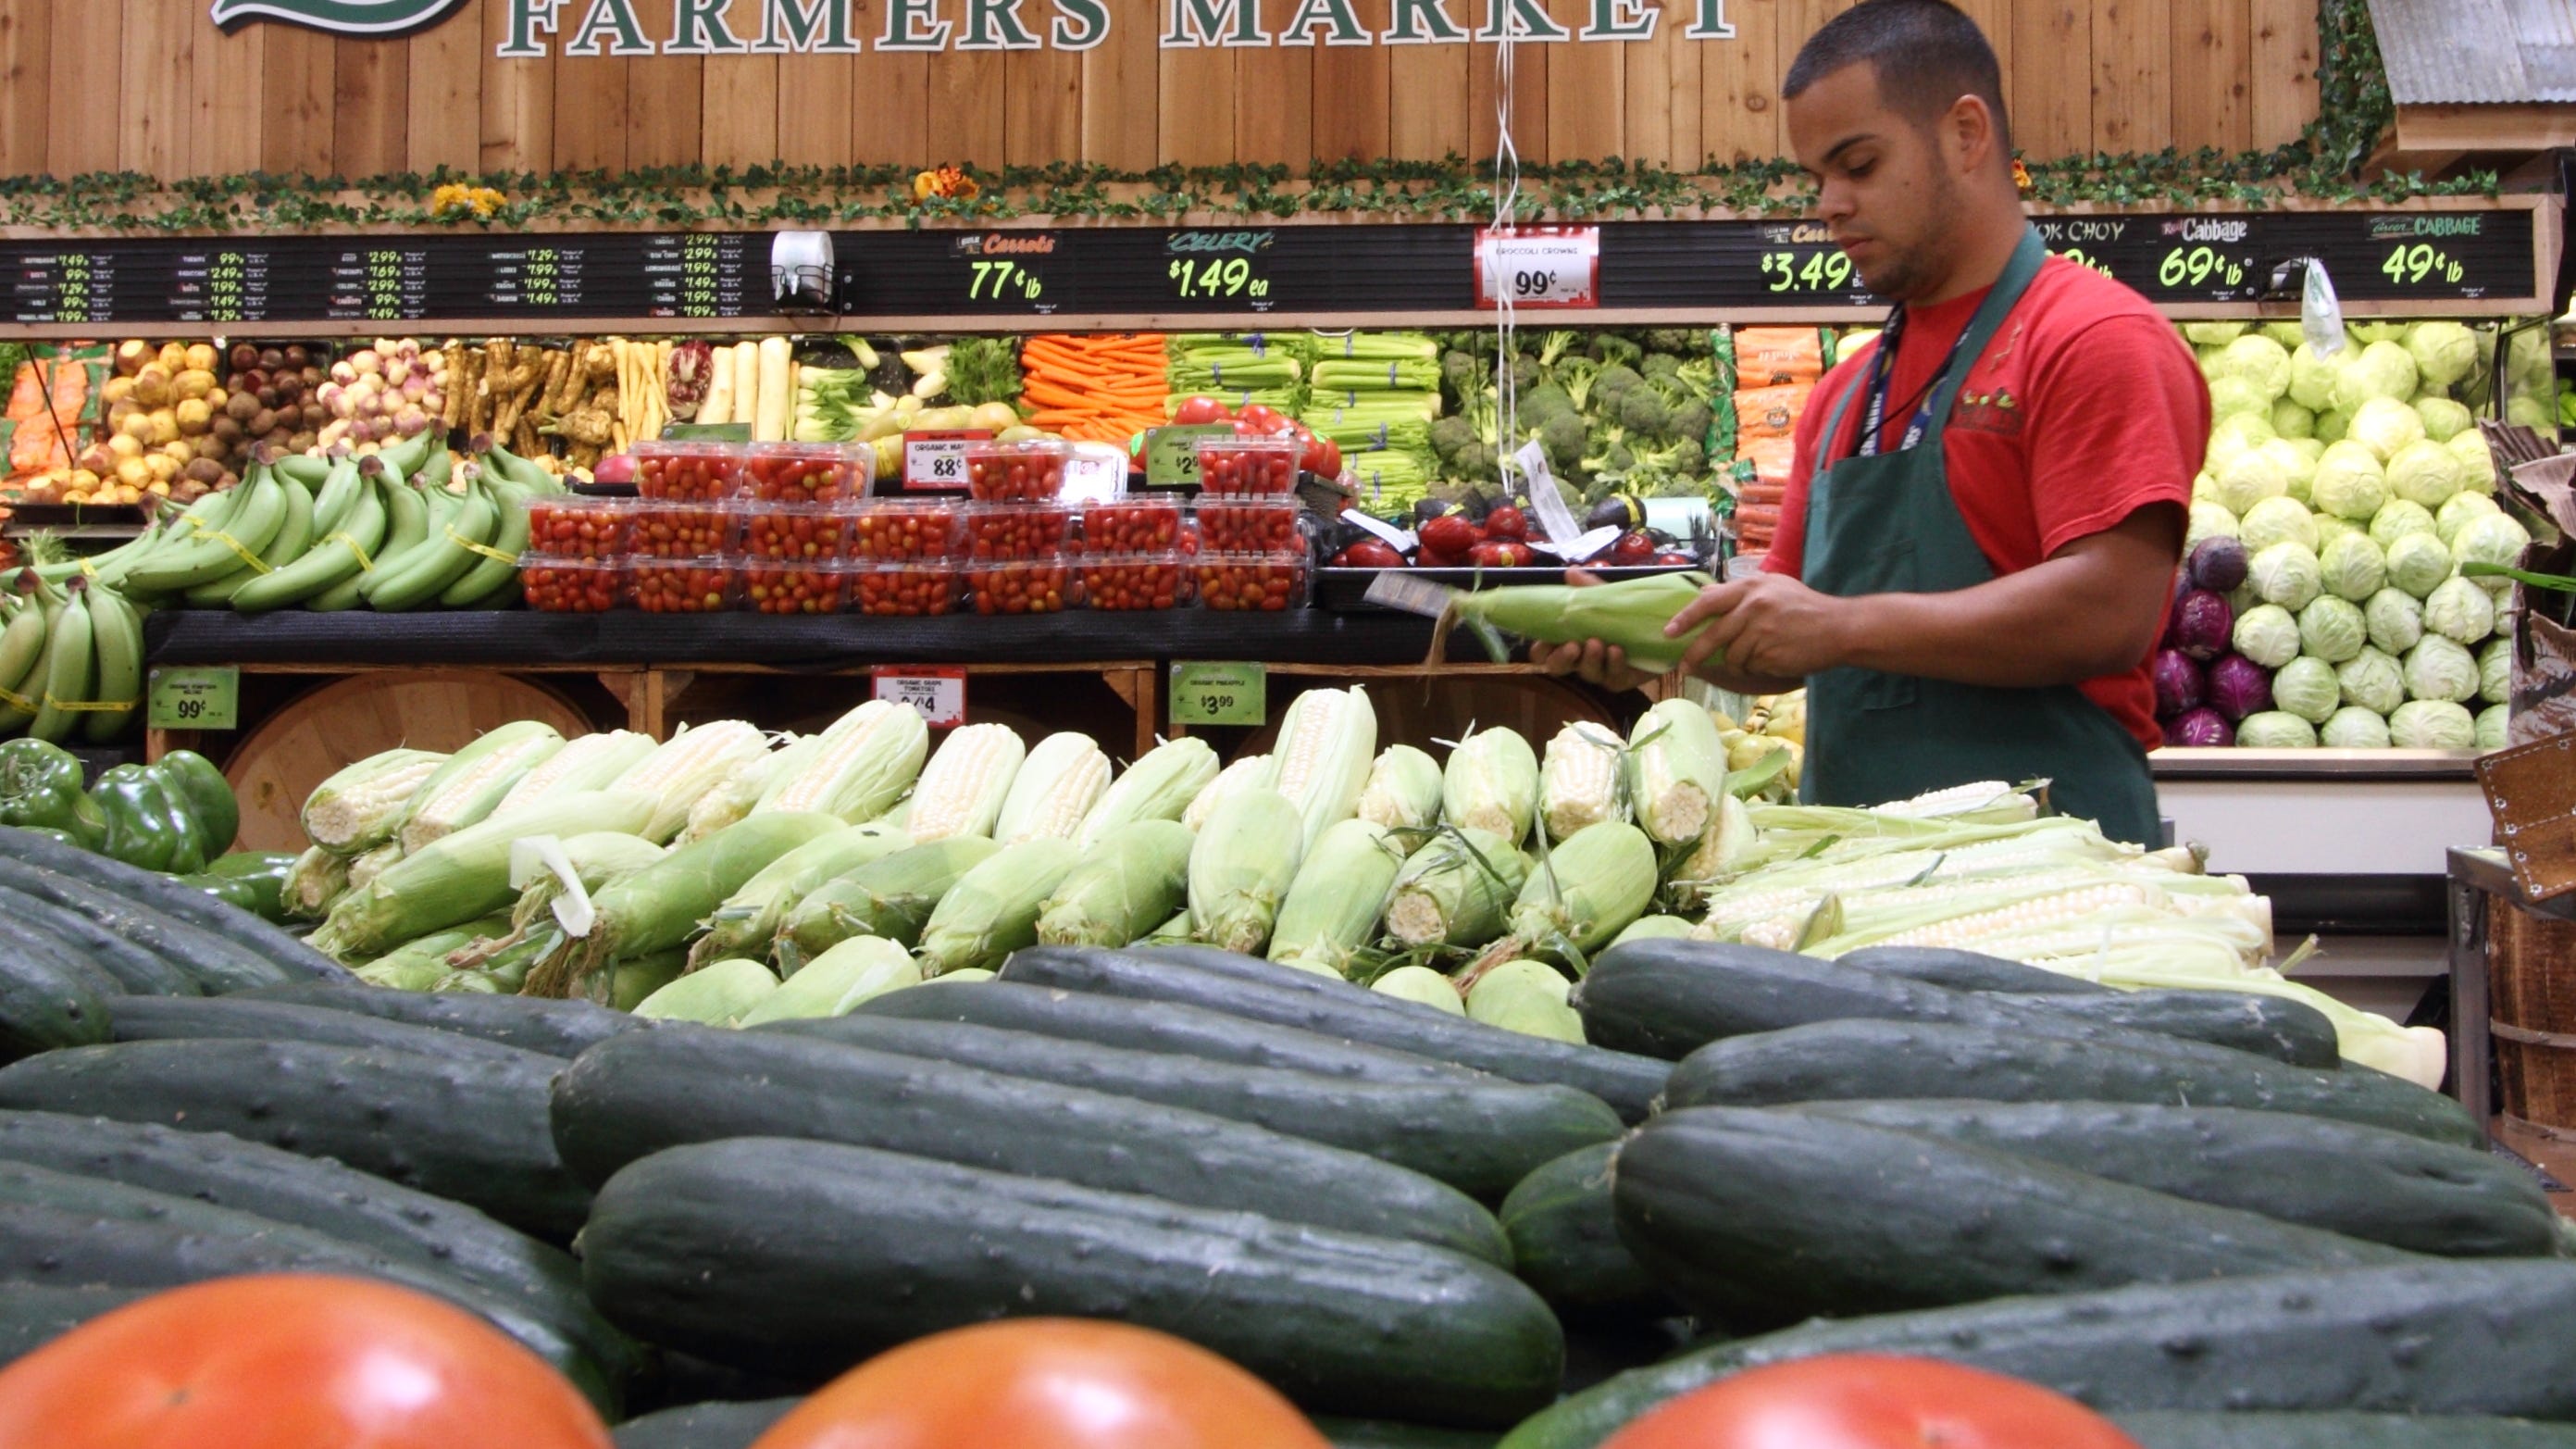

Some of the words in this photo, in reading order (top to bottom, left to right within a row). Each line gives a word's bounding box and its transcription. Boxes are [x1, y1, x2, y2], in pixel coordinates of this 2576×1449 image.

[496, 0, 1112, 58] FARMERS
[2035, 223, 2063, 242] OK
[2068, 220, 2124, 242] CHOY
[2183, 218, 2247, 242] Cabbage
[2414, 217, 2481, 237] CABBAGE
[983, 233, 1055, 254] Carrots
[1169, 231, 1274, 253] CELERY
[1169, 258, 1249, 297] $1.49
[1249, 279, 1268, 296] ea
[1515, 269, 1557, 295] 99¢
[1761, 251, 1851, 292] $3.49
[2226, 263, 2243, 285] lb
[2446, 261, 2463, 282] lb
[1025, 278, 1041, 299] lb
[934, 457, 962, 477] 88¢
[178, 700, 206, 718] 99¢
